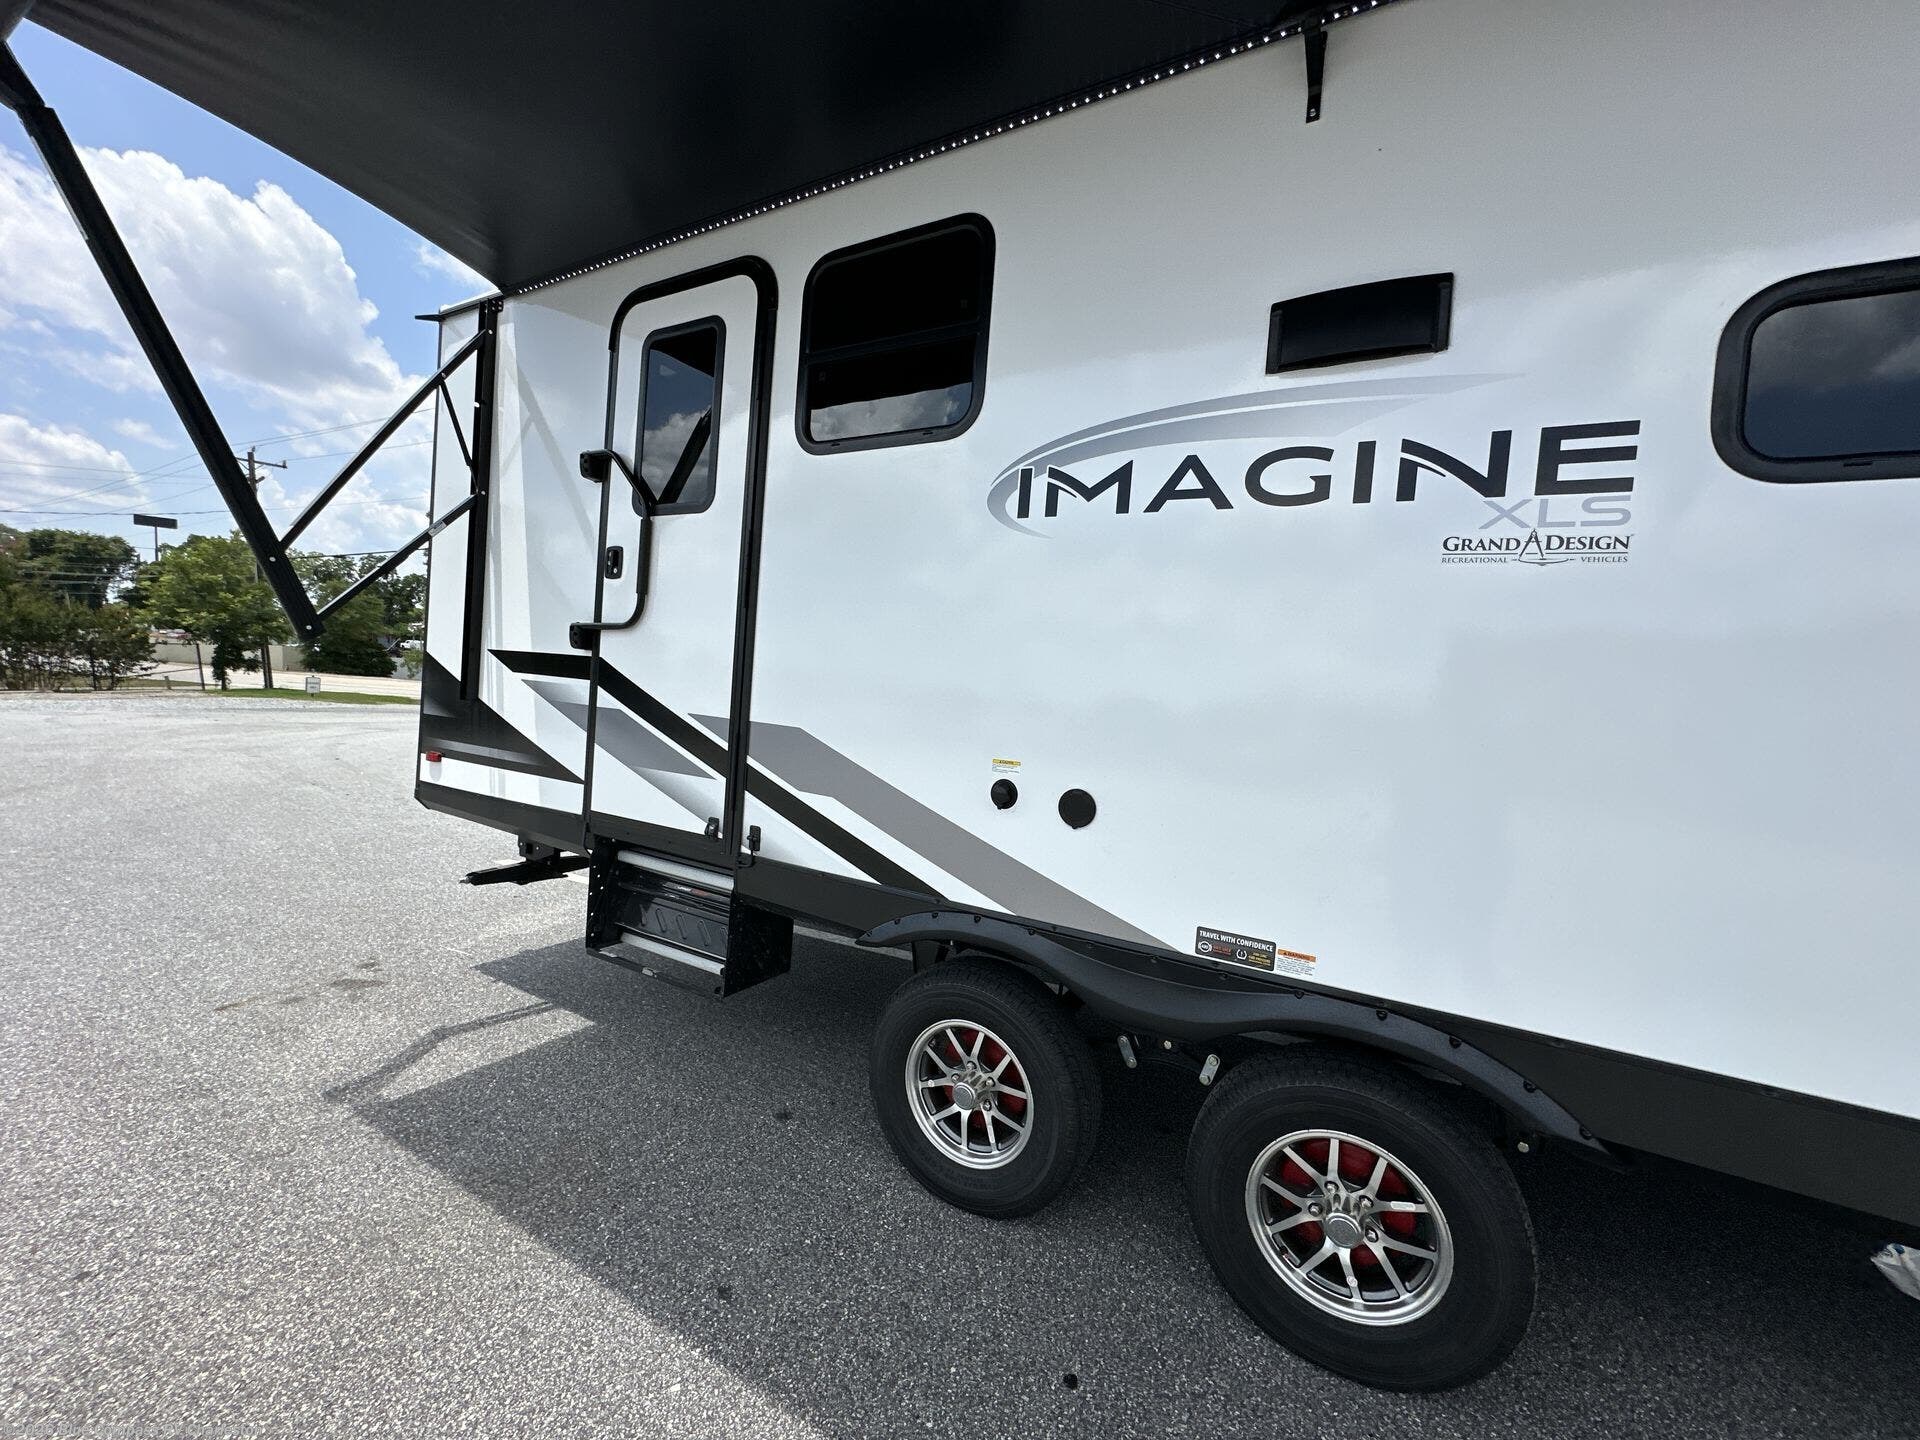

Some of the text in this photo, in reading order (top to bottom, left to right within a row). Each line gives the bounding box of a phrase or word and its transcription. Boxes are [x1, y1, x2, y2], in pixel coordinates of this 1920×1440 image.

[1017, 419, 1641, 519] IMAGINE
[1478, 495, 1631, 529] XLS
[1442, 534, 1630, 552] GRAND DESIGN
[1441, 555, 1628, 564] RECREATIONAL VEHICLES
[1200, 930, 1220, 940] TRAVEL
[1220, 934, 1236, 944] WITH
[1236, 938, 1273, 952] CONFIDENCE
